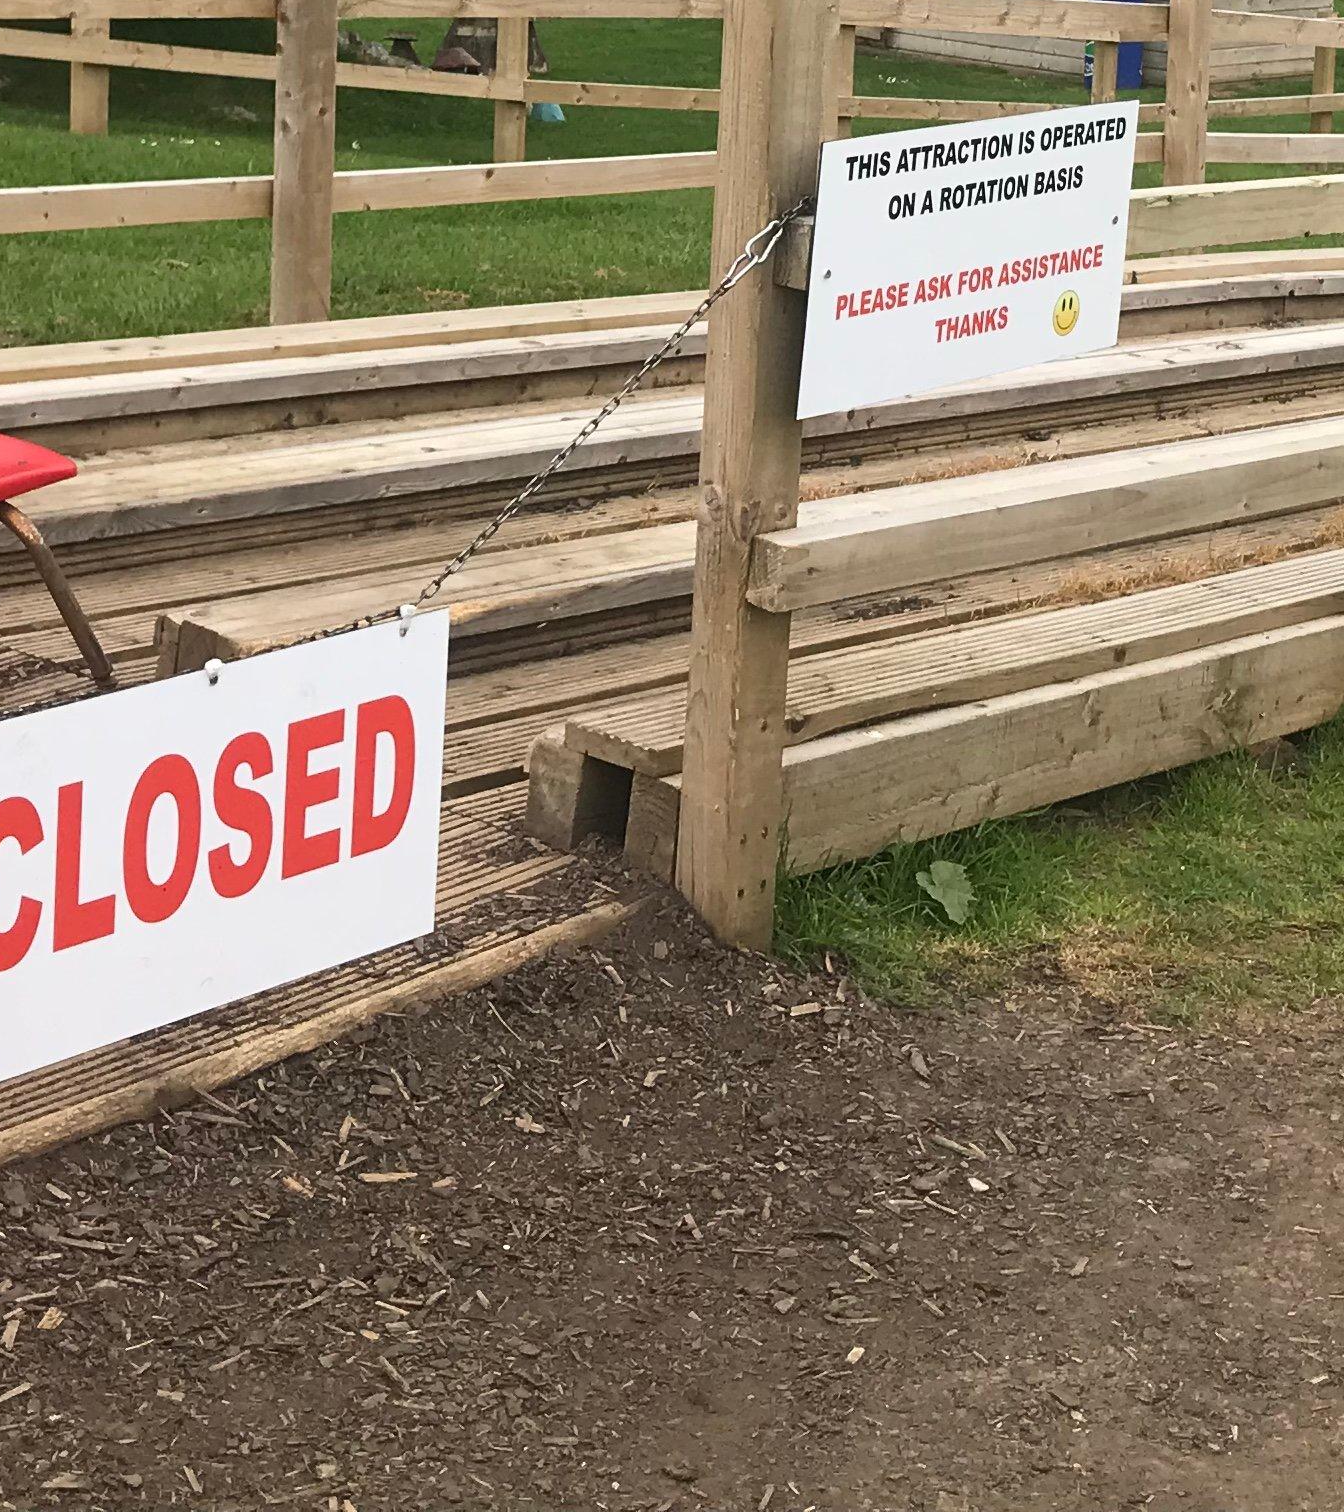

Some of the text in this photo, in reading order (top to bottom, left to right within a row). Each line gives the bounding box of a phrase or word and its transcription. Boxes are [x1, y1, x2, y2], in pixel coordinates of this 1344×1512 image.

[846, 116, 1126, 181] THIS ATTRACTION IS OPERATED
[888, 165, 1083, 220] ON A ROTATION BASIS
[835, 244, 1104, 320] PLEASE ASK FOR ASSISTANCE
[935, 306, 1008, 343] THANKS
